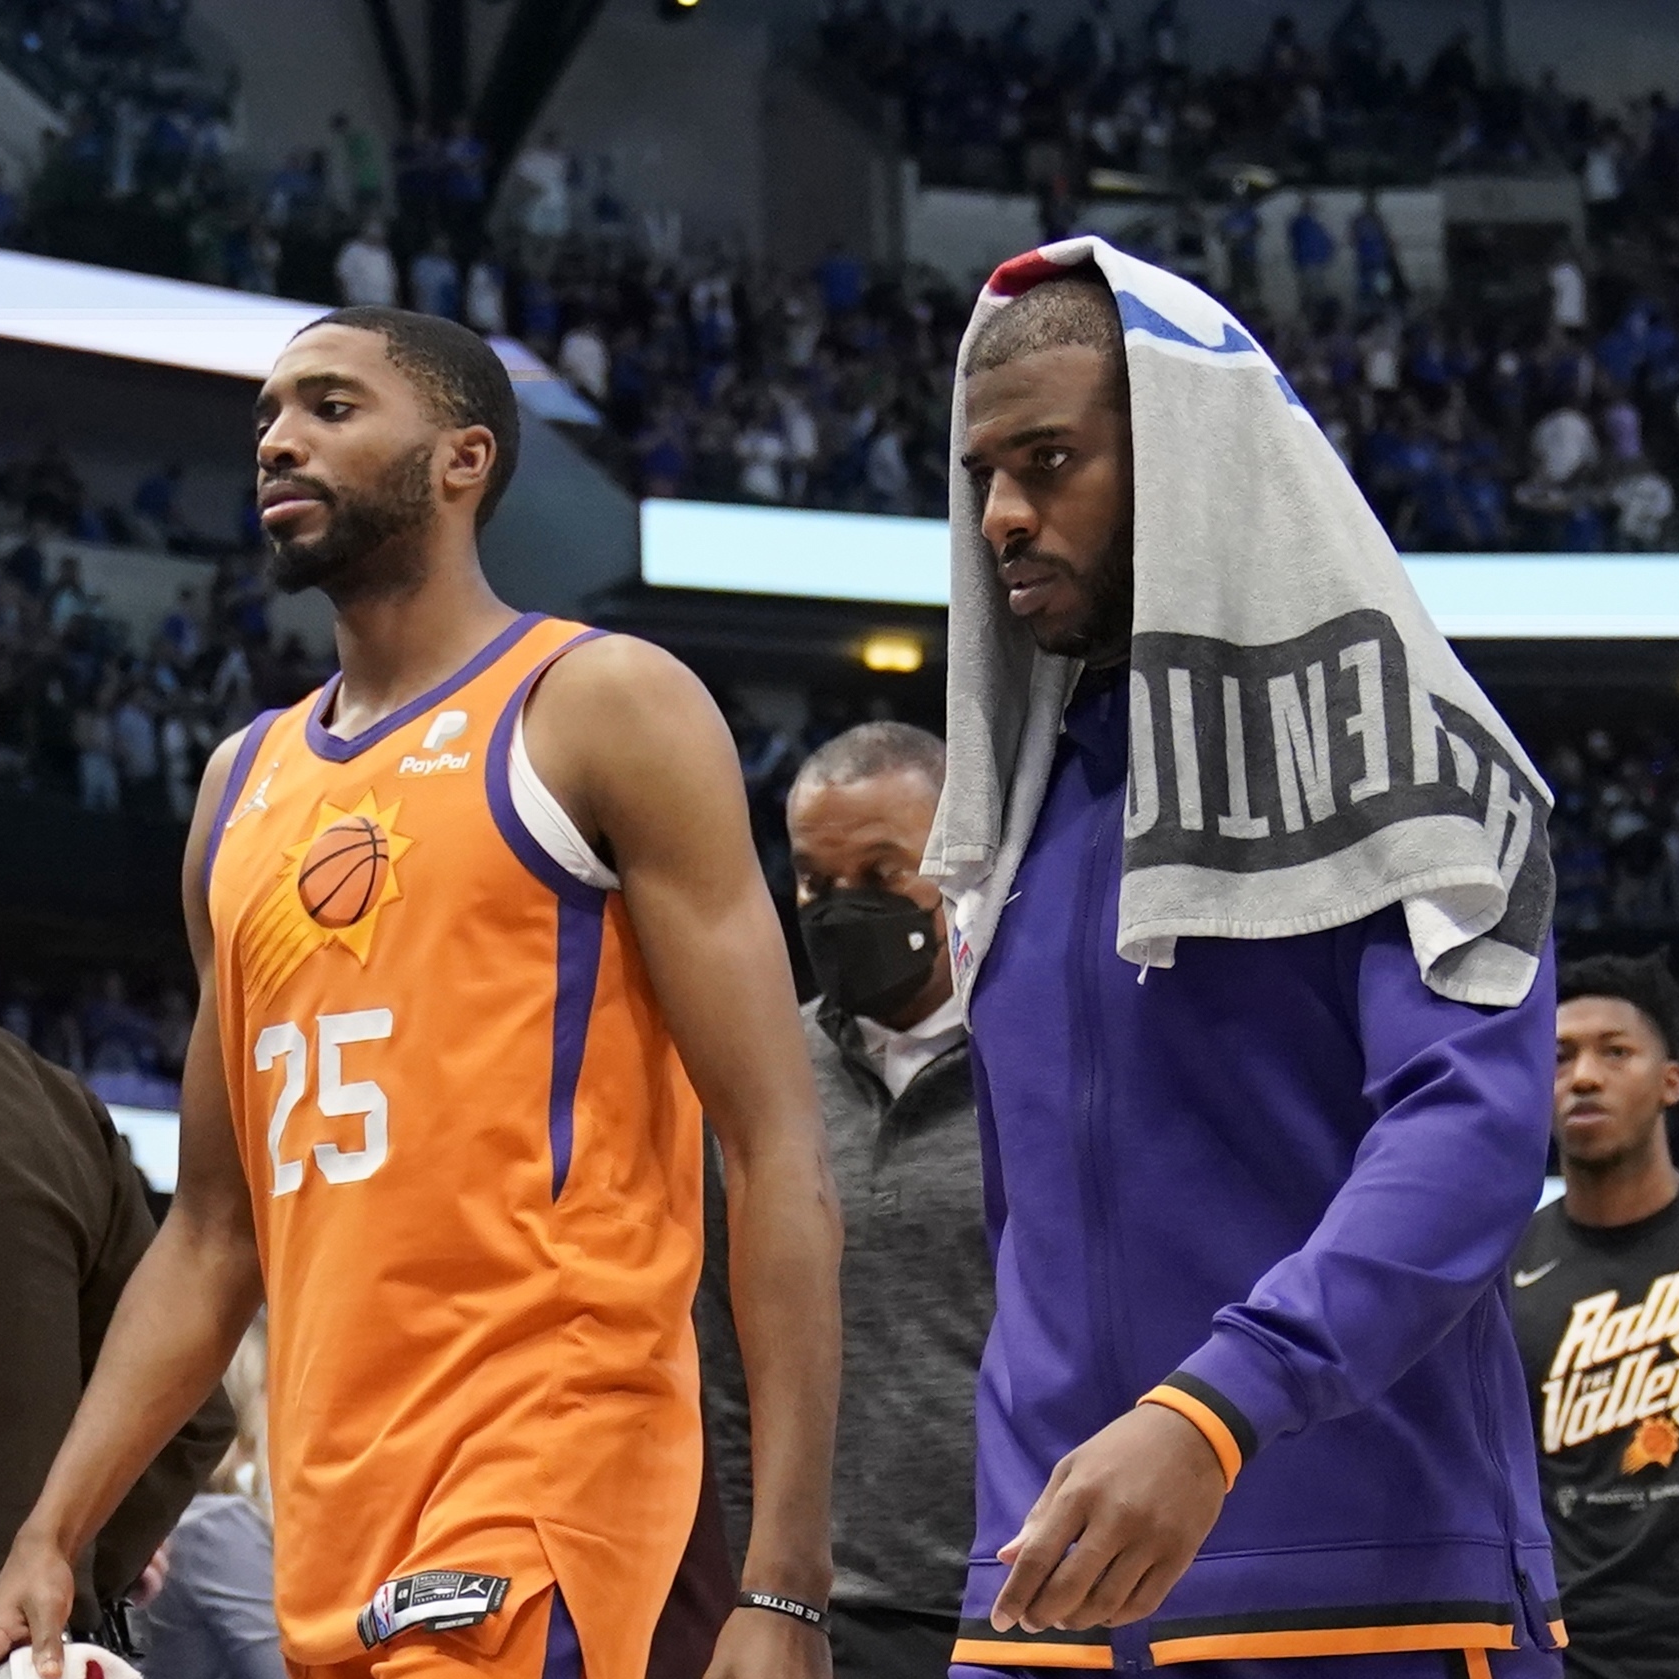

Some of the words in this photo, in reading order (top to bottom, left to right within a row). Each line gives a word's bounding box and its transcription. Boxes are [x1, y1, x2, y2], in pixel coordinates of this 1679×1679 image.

[398, 751, 471, 776] PayPal
[253, 1007, 394, 1199] 25
[1582, 1367, 1615, 1394] THE
[805, 1609, 821, 1623] BE
